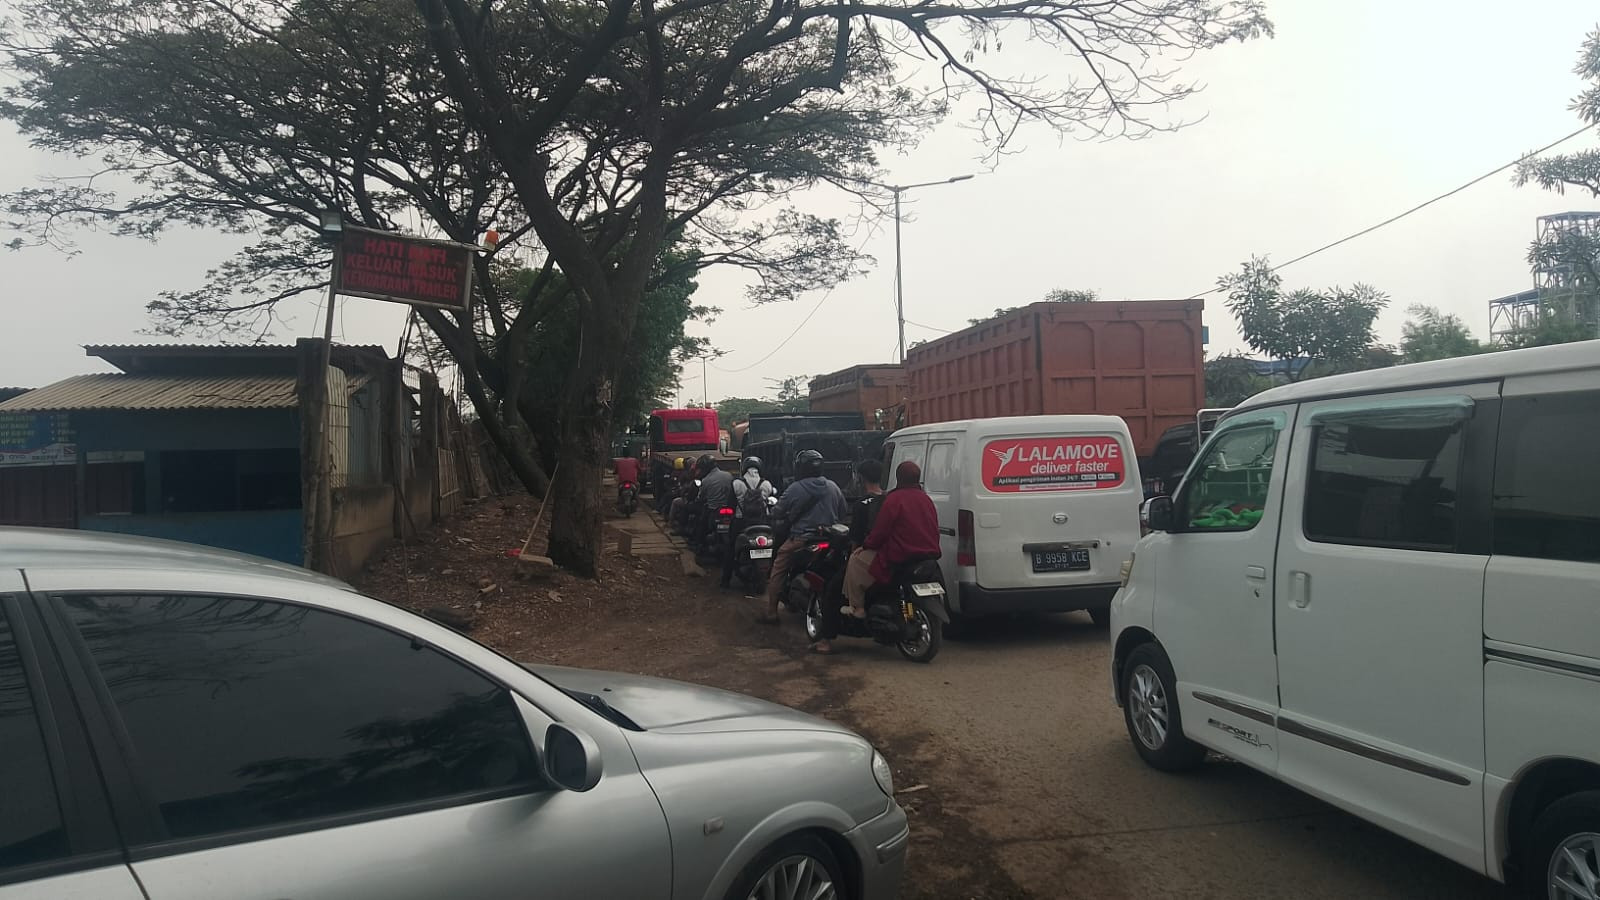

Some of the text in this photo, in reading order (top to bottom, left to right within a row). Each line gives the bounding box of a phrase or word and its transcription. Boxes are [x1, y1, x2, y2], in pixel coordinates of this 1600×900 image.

[364, 240, 404, 257] HATI
[345, 253, 403, 274] KELUAR
[414, 280, 458, 299] TRAILER
[1018, 444, 1118, 462] LALAMOVE
[1030, 461, 1110, 475] deliver faster
[1036, 551, 1088, 564] B 9958 KCE
